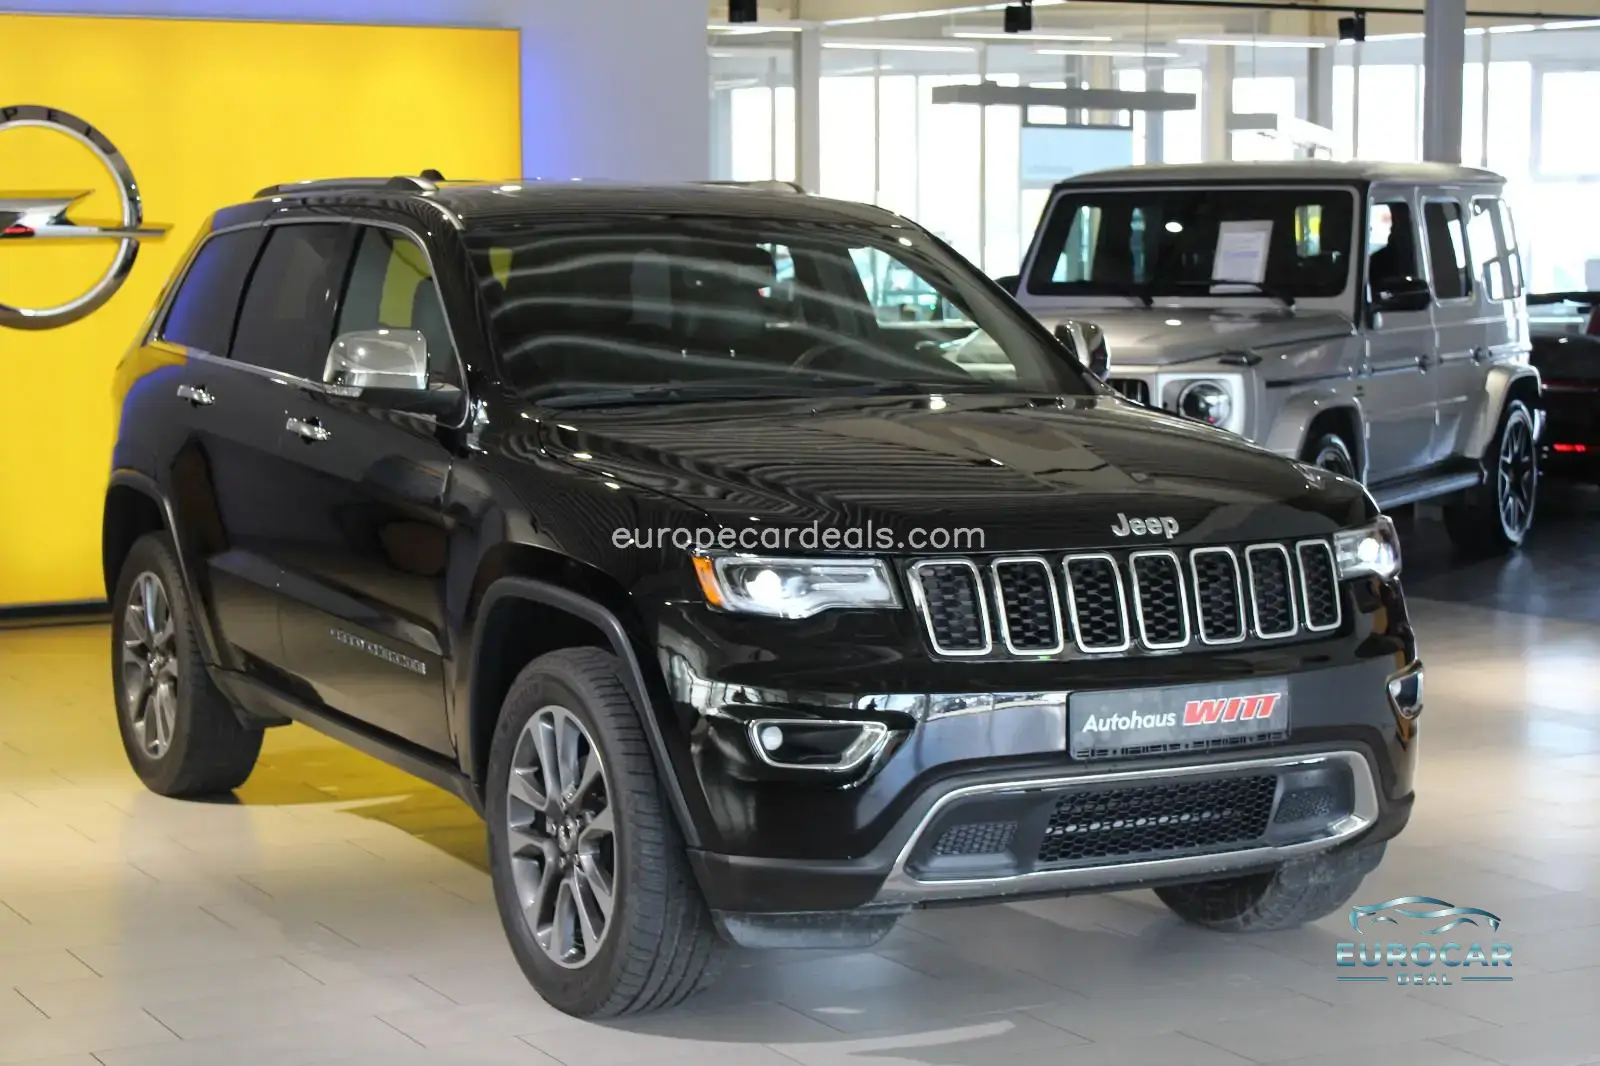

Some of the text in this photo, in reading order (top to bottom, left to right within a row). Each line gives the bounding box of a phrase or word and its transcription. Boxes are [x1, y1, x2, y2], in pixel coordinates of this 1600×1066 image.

[1111, 512, 1180, 540] Jeep
[1082, 692, 1282, 733] Autohaus WITT
